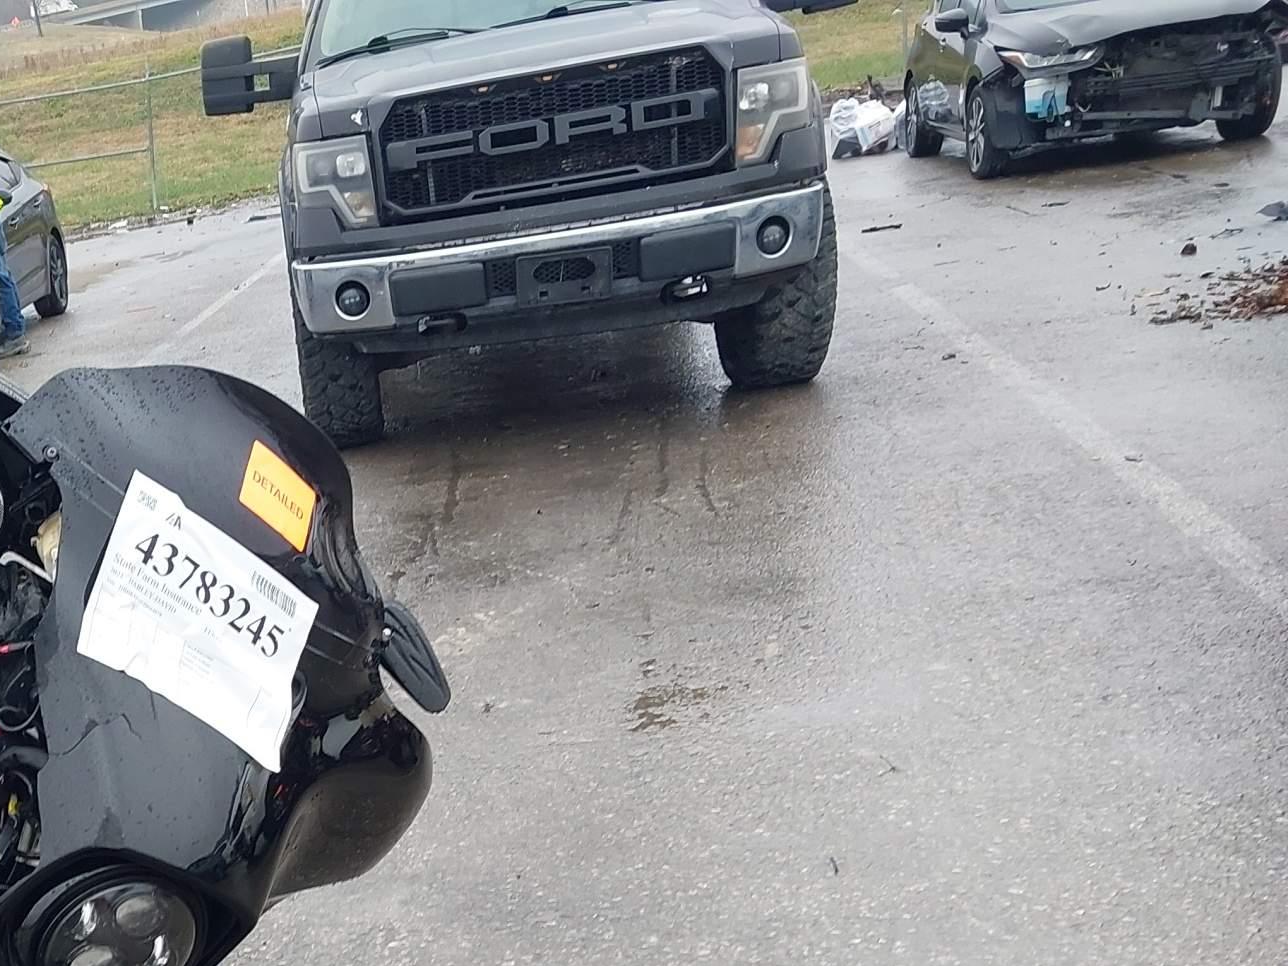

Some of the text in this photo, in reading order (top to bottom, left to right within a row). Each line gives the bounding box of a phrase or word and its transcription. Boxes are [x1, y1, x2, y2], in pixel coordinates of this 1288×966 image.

[386, 88, 719, 171] FORD
[253, 469, 304, 520] DETAILED
[113, 552, 137, 574] State
[137, 567, 160, 589] Farm
[160, 583, 202, 616] Insurance
[135, 533, 285, 658] 43783245
